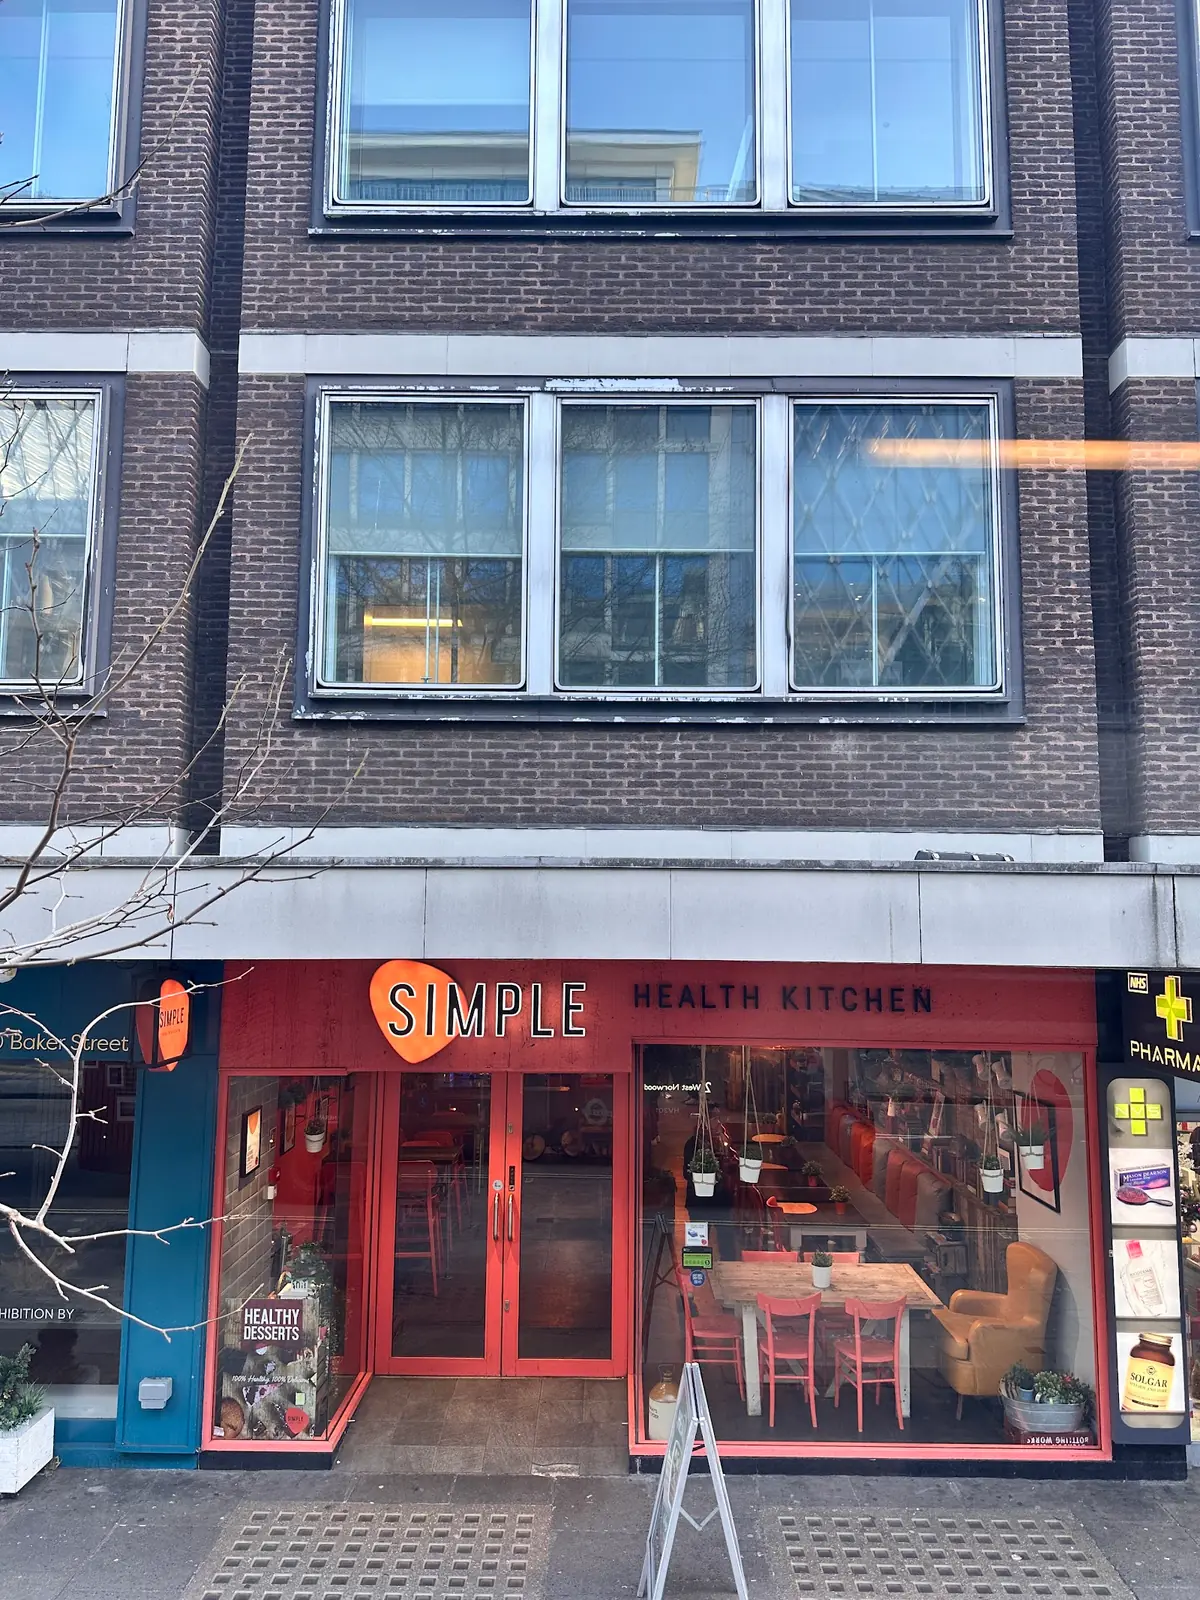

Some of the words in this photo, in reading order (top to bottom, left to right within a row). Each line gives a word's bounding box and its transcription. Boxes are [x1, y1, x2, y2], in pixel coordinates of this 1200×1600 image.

[1130, 976, 1147, 990] NHS
[633, 983, 760, 1010] HEALTH
[782, 985, 932, 1013] KITCHEN
[159, 1007, 185, 1029] SIMPLE
[388, 982, 586, 1038] SIMPLE
[10, 1034, 66, 1051] Baker
[71, 1034, 129, 1052] Street
[57, 1308, 75, 1320] BY
[244, 1308, 300, 1325] HEALTHY
[243, 1325, 300, 1341] DESSERTS
[231, 1375, 247, 1383] 100%
[247, 1374, 270, 1385] Healthy
[1130, 1372, 1168, 1388] SOLGAR
